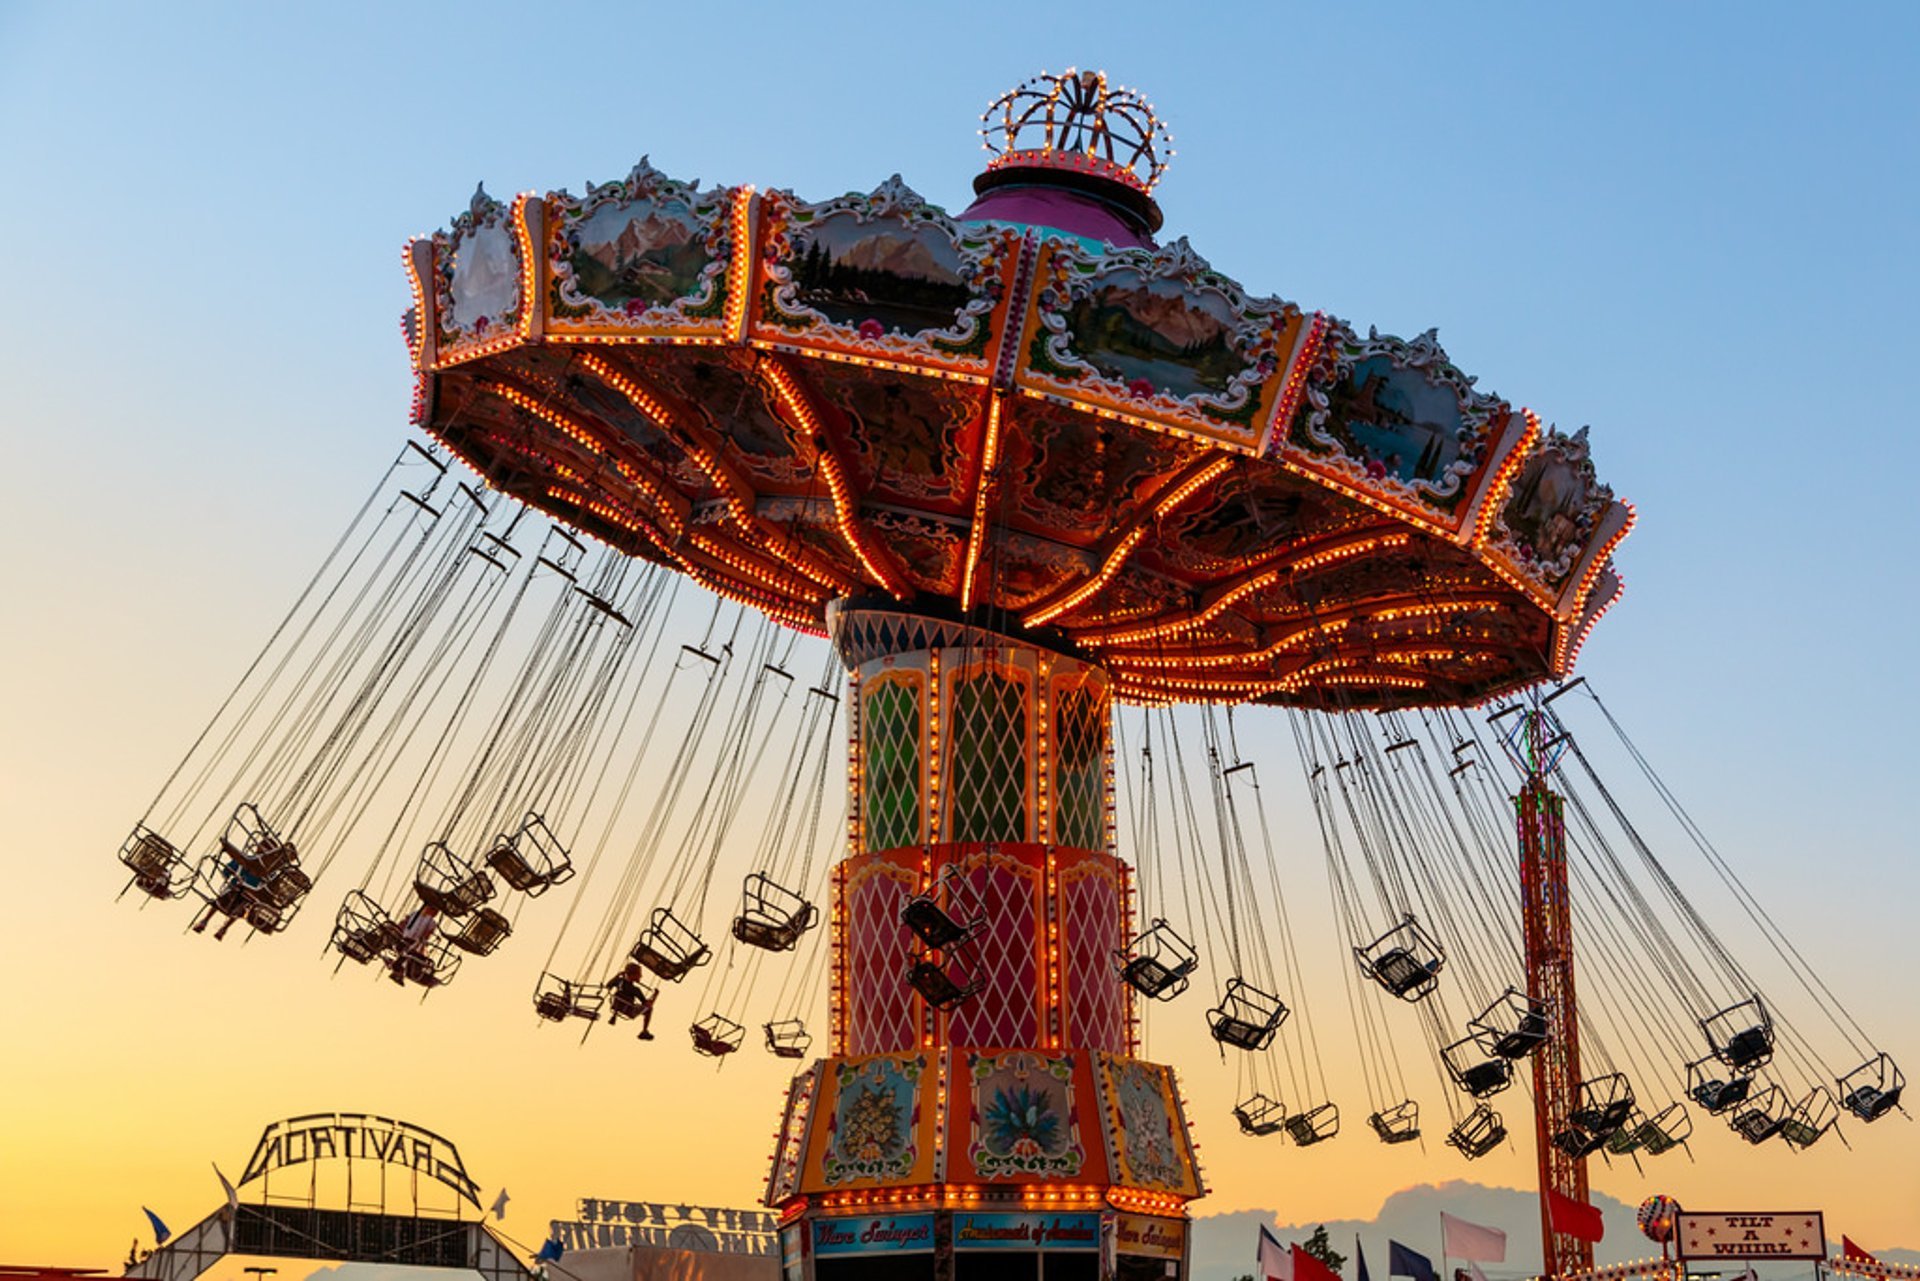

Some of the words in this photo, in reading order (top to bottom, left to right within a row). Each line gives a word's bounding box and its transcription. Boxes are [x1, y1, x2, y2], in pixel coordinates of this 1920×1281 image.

[1725, 1217, 1773, 1227] TILT
[1743, 1230, 1759, 1240] A
[1713, 1243, 1792, 1254] WHIRL
